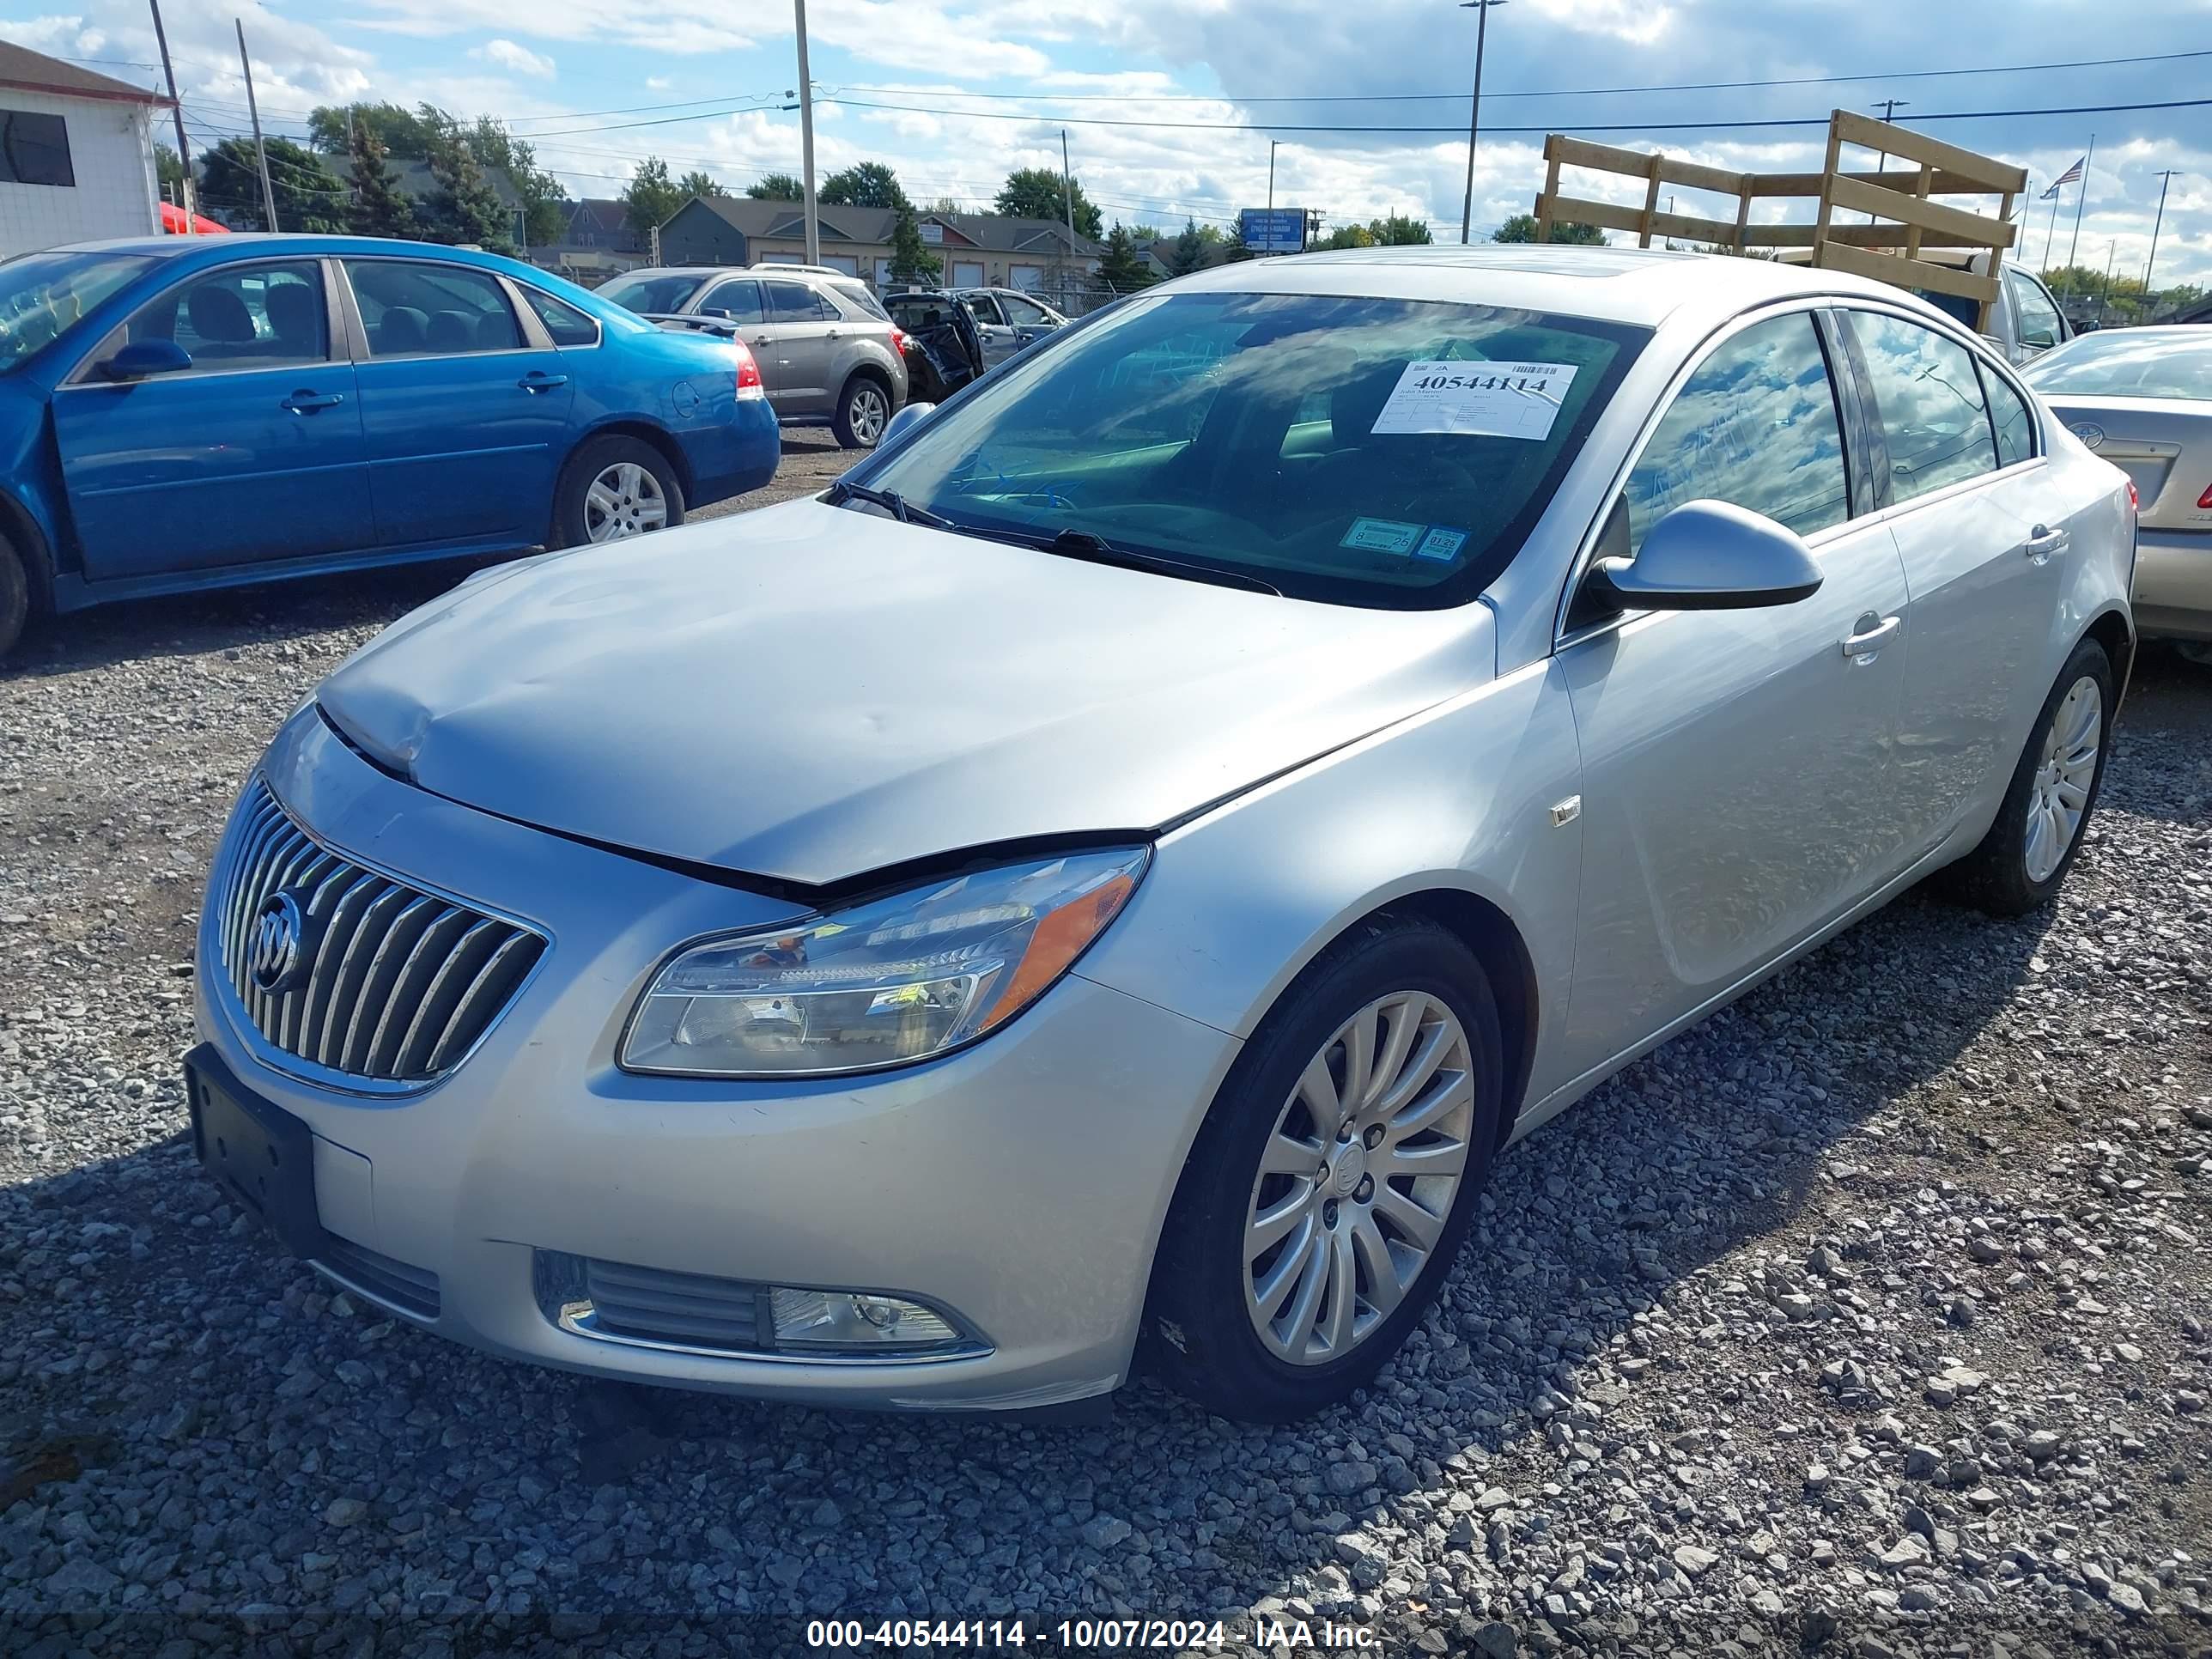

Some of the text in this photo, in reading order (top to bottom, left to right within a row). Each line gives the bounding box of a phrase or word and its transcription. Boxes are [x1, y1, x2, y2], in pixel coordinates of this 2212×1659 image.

[1413, 375, 1548, 392] 40544114
[1355, 532, 1365, 541] 8
[1392, 537, 1411, 547] 25
